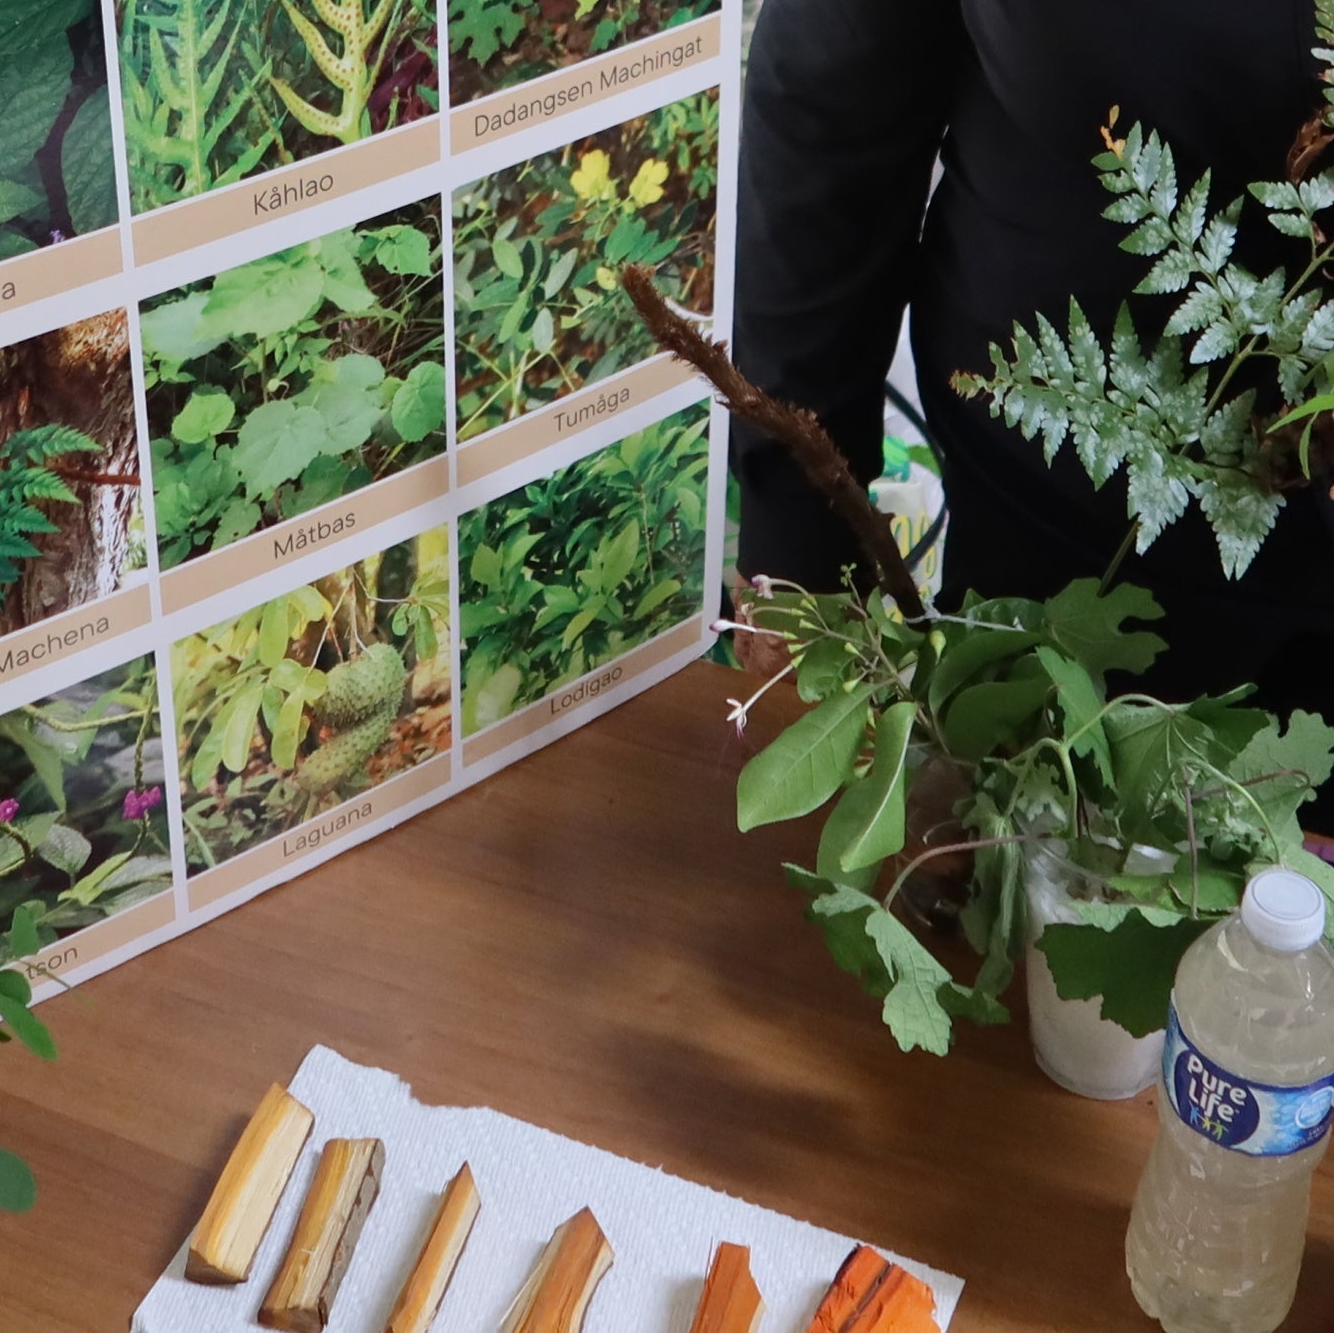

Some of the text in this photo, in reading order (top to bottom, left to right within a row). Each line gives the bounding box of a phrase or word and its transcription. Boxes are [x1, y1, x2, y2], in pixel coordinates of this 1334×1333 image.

[475, 36, 702, 137] Dadangsen Machingat
[254, 175, 333, 215] Kåhlao
[554, 388, 629, 432] Tumåga
[274, 512, 355, 559] Måtbas
[551, 667, 622, 715] Lodigao
[283, 803, 371, 857] Laguana
[1187, 1054, 1247, 1106] Pure
[1189, 1081, 1235, 1123] Life
